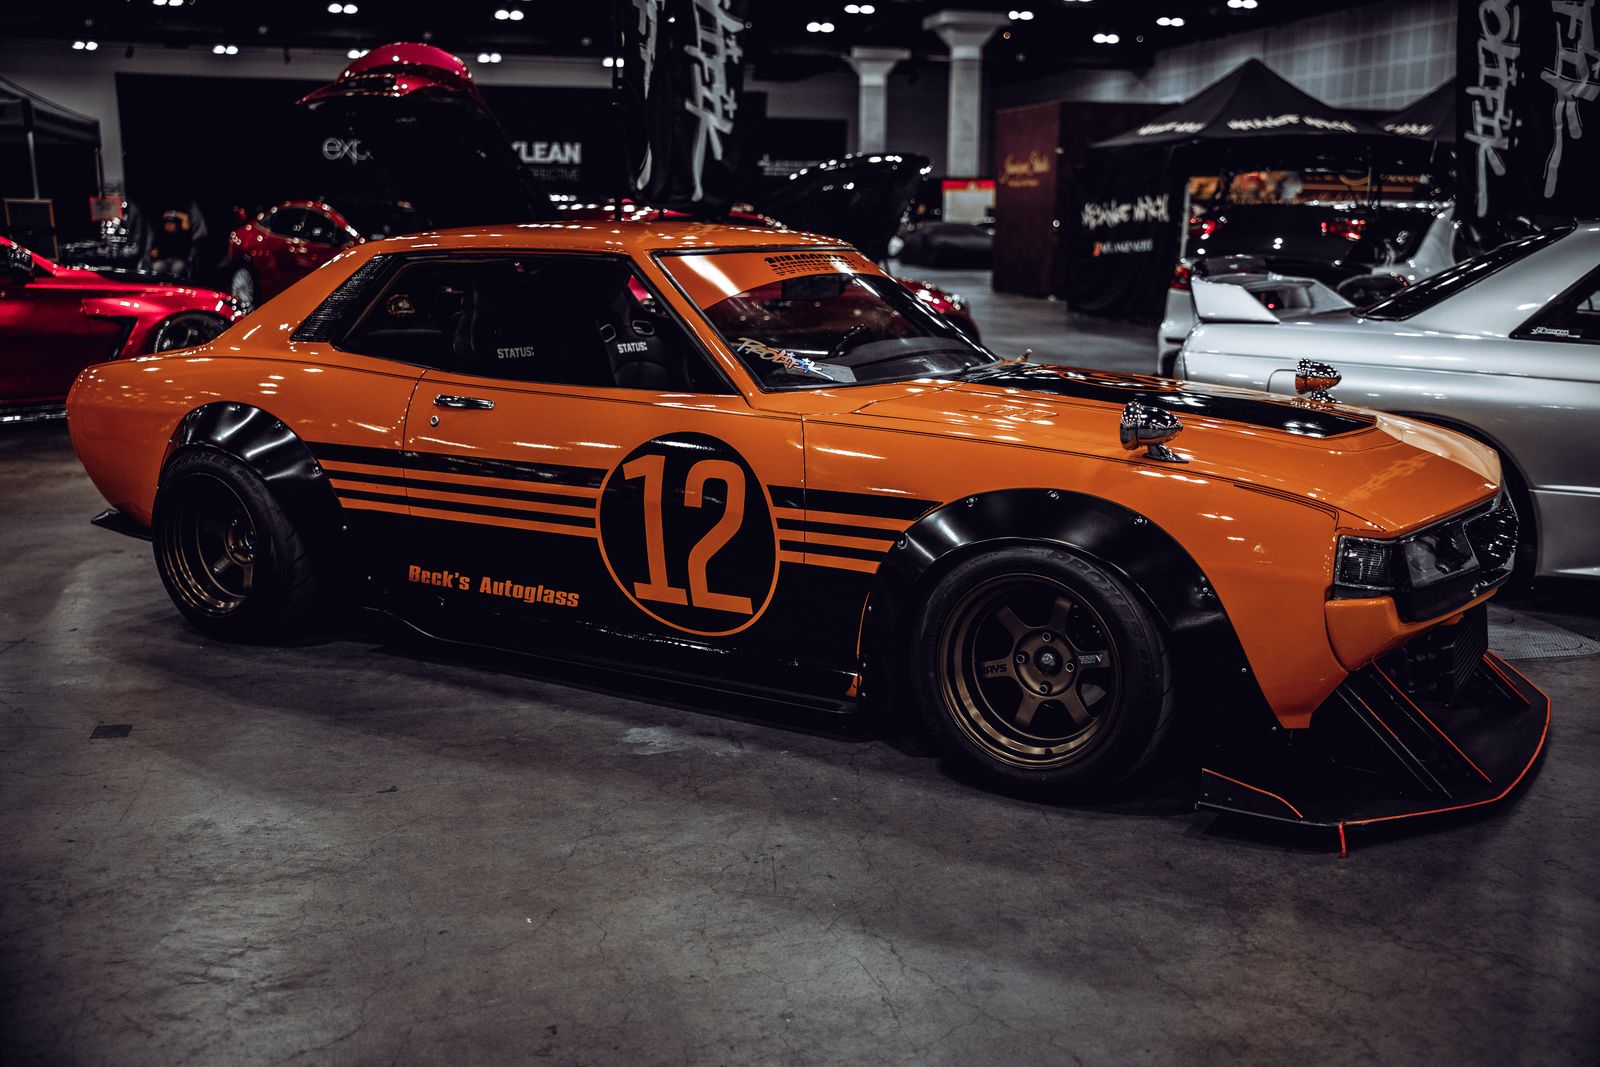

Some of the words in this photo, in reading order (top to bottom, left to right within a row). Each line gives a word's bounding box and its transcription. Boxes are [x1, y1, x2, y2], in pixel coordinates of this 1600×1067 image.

[622, 454, 754, 615] 12
[408, 564, 471, 591] Beck's
[479, 576, 580, 608] Autoglass
